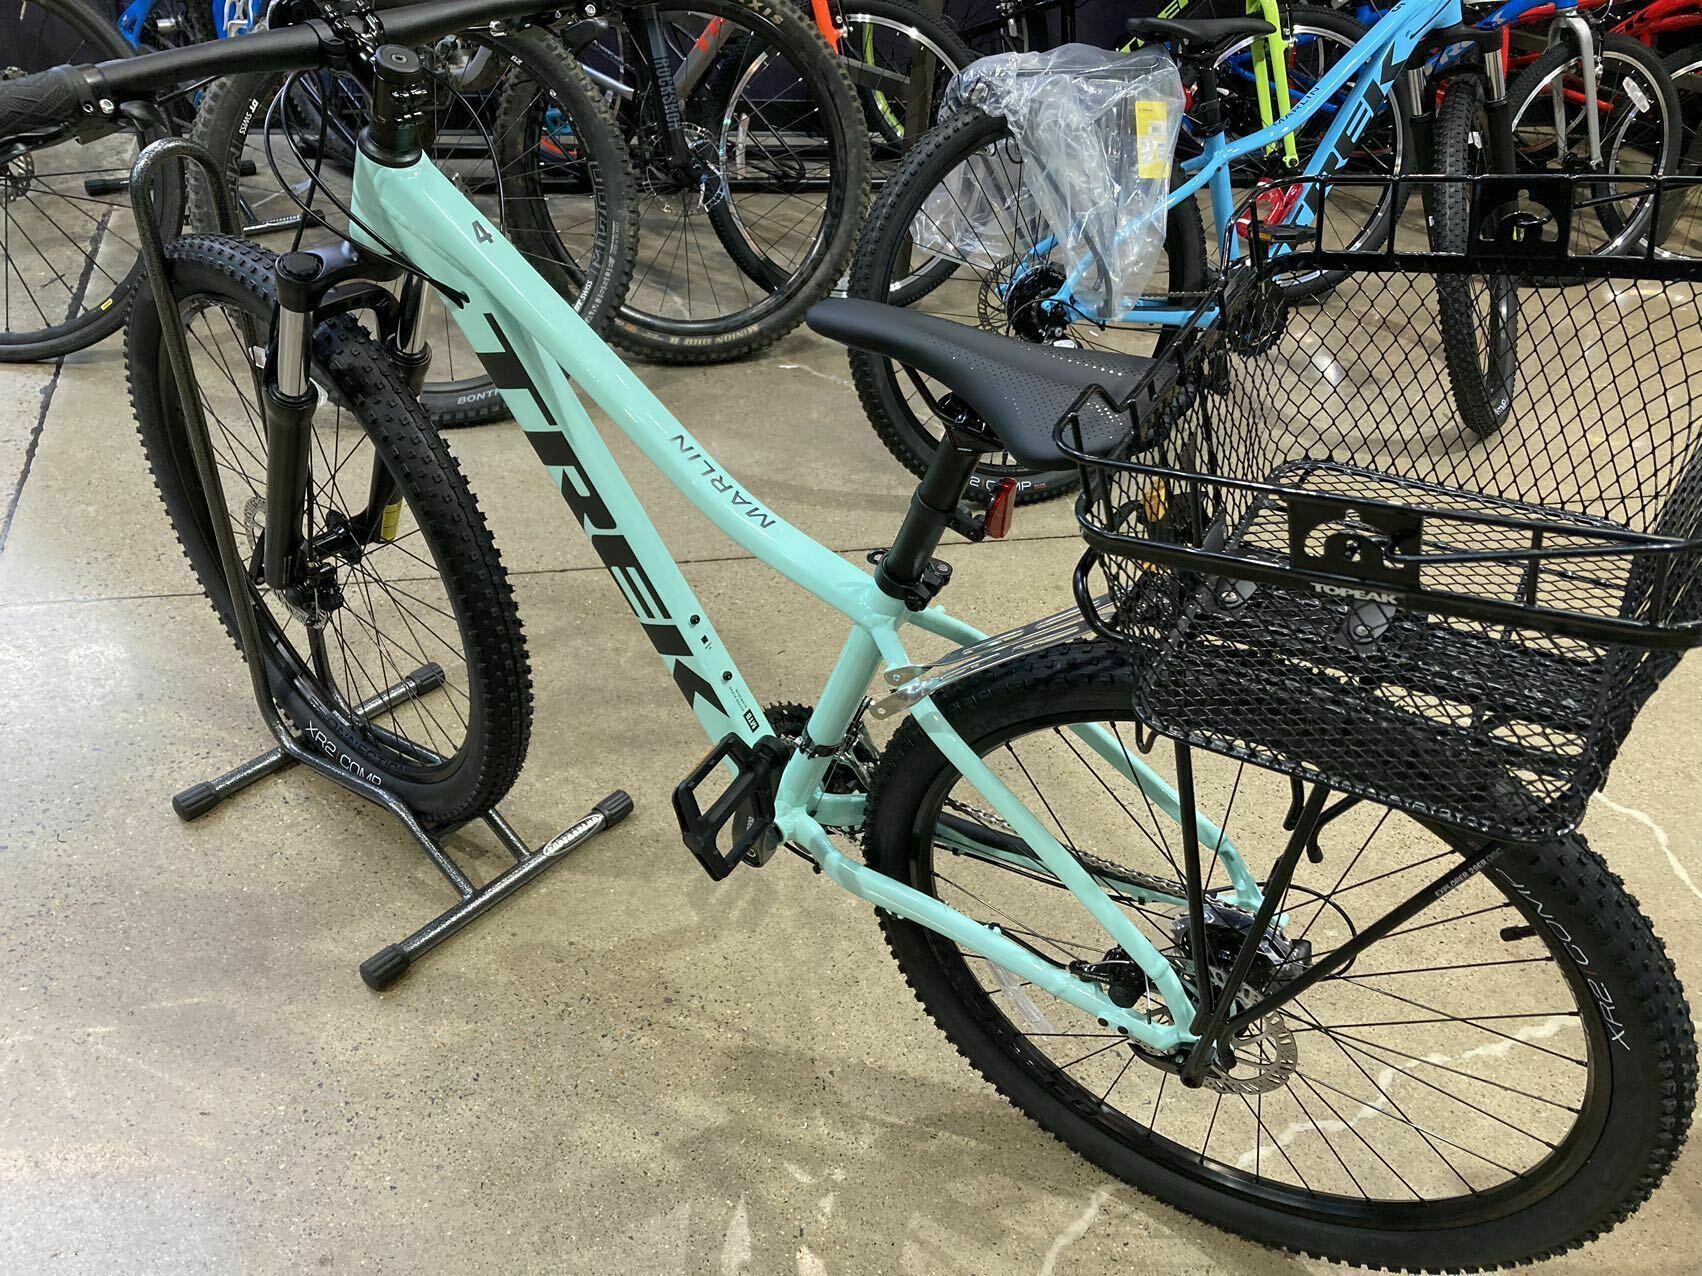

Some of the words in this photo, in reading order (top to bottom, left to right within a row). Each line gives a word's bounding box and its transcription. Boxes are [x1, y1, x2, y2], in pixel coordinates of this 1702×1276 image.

[738, 0, 784, 25] XIS
[249, 98, 259, 114] DT
[1273, 86, 1320, 127] MARLIN
[238, 111, 253, 135] SWISS
[471, 219, 495, 245] 4
[580, 279, 594, 301] SWISS
[669, 433, 777, 529] MARLIN
[985, 479, 1032, 492] CMP
[475, 312, 731, 719] TREK
[1309, 582, 1399, 605] TOPEAK
[745, 711, 759, 730] MTB
[305, 720, 337, 758] XR2
[1434, 871, 1470, 898] EXPLORER
[1587, 977, 1631, 1051] XR2
